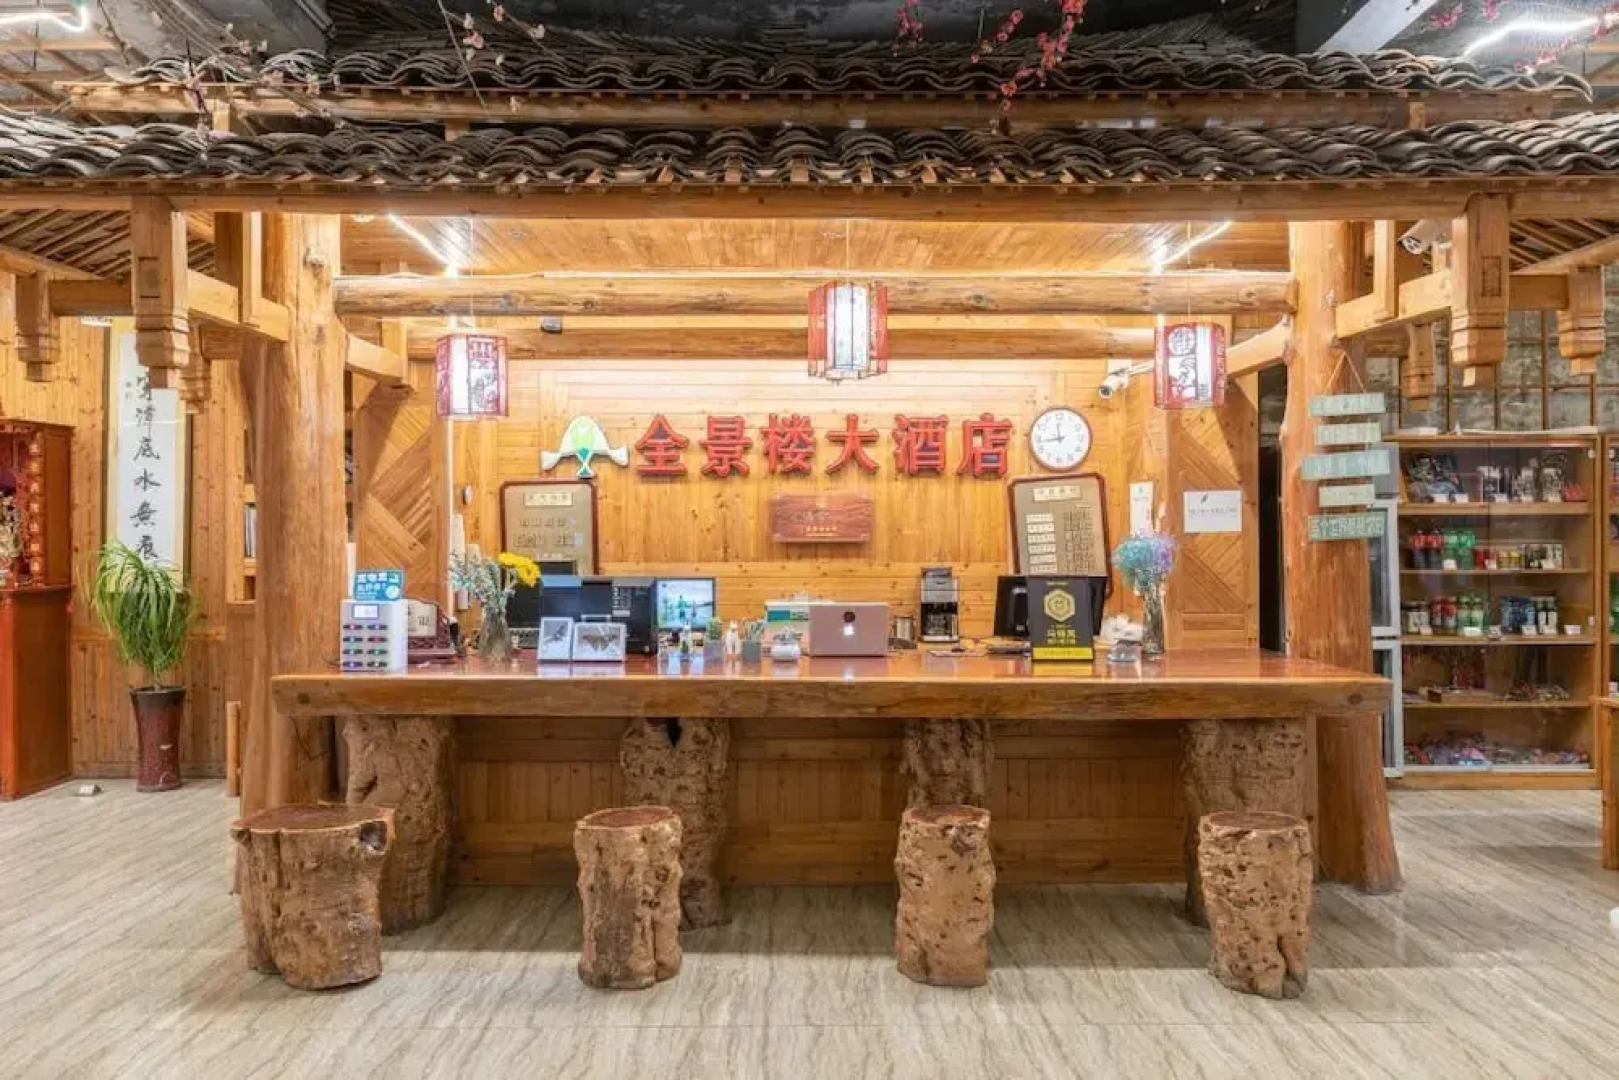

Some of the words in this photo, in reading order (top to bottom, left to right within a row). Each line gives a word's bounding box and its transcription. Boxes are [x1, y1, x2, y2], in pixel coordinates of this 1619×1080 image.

[635, 413, 1013, 478] 全景楼大酒店
